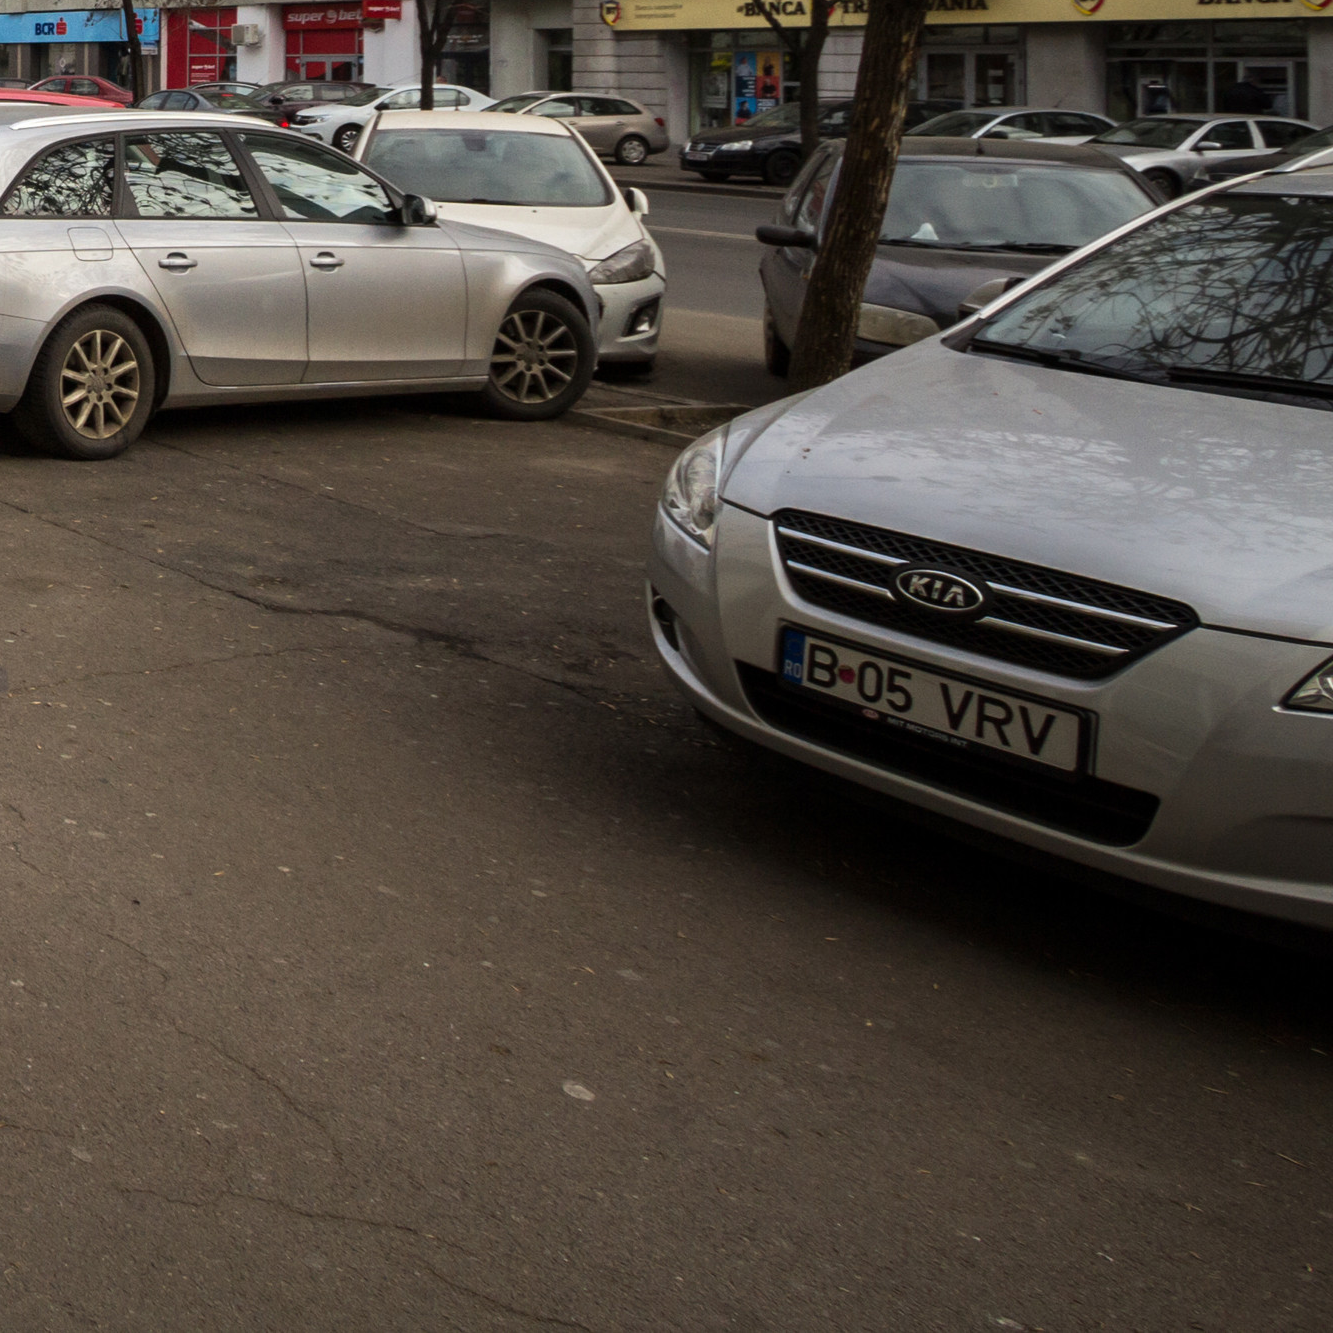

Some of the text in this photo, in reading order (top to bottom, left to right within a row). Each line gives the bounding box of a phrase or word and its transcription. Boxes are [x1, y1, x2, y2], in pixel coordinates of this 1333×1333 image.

[35, 22, 55, 35] BCR
[907, 574, 966, 607] KIA
[784, 659, 801, 679] RO
[806, 643, 1057, 756] B 05 VRV
